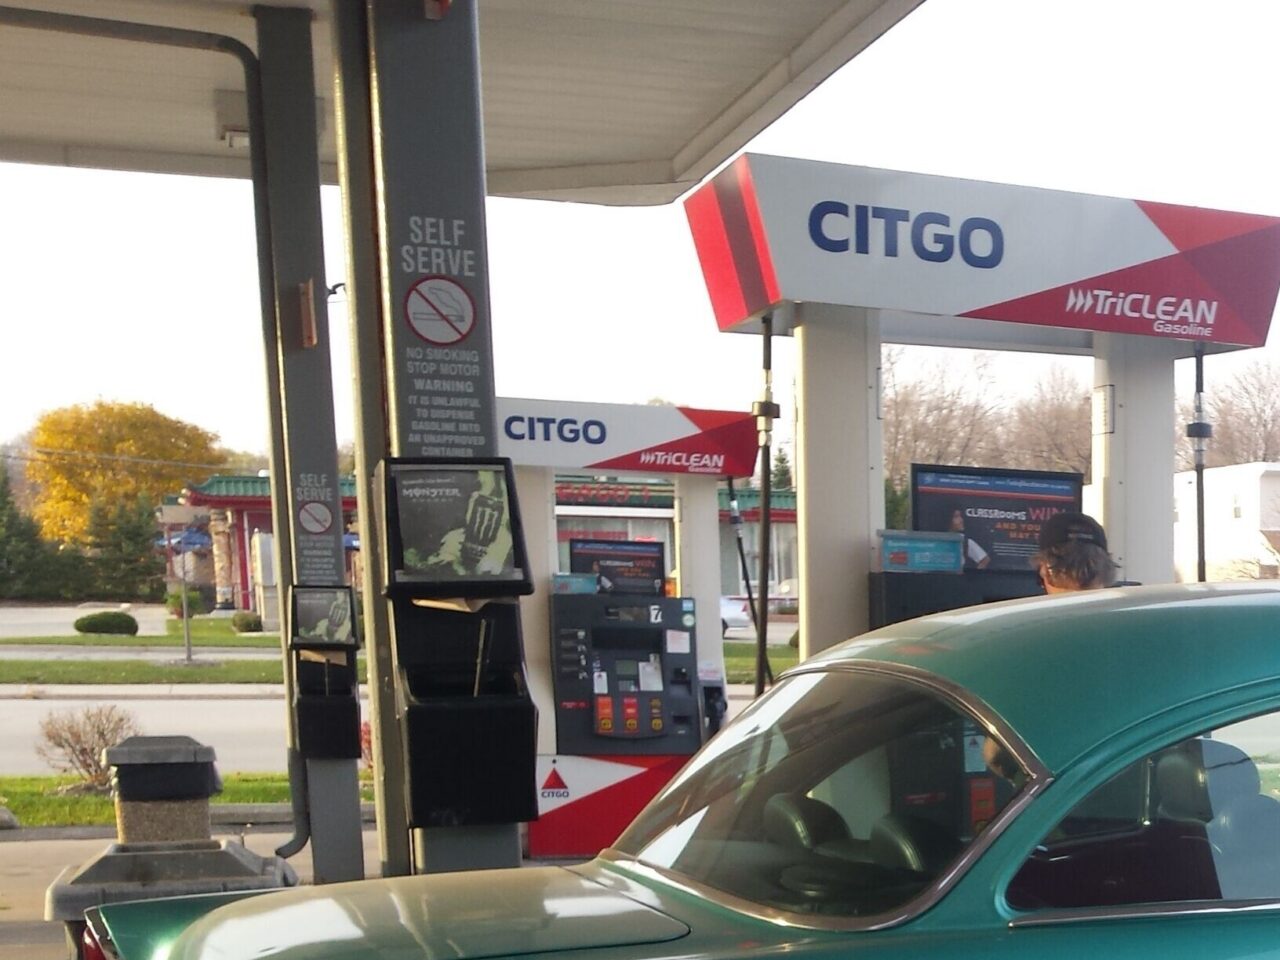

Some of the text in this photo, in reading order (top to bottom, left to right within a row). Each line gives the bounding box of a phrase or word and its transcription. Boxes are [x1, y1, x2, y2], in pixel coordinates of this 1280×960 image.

[409, 216, 465, 246] SELF
[807, 200, 1005, 269] CITGO
[401, 244, 476, 277] SERVE
[1092, 288, 1219, 325] TriCLEAN
[1152, 319, 1214, 337] Gasoline
[406, 347, 479, 362] NO SMOKING
[407, 361, 481, 377] STOP MOTOR
[413, 379, 475, 393] WARNING
[431, 396, 482, 408] UNLAWFUL
[416, 408, 429, 418] TO
[411, 421, 481, 433] GASOLINE INTO
[503, 415, 607, 445] CITGO
[423, 434, 486, 446] UNAPPROVED
[421, 446, 474, 458] CONTAINER
[654, 450, 726, 468] TriCLEAN
[300, 473, 329, 487] SELF
[296, 486, 333, 501] SERVE
[402, 486, 461, 498] MONSTER
[965, 507, 1027, 521] CLASSROOMS
[651, 606, 661, 622] 7
[541, 790, 570, 798] CITGO
